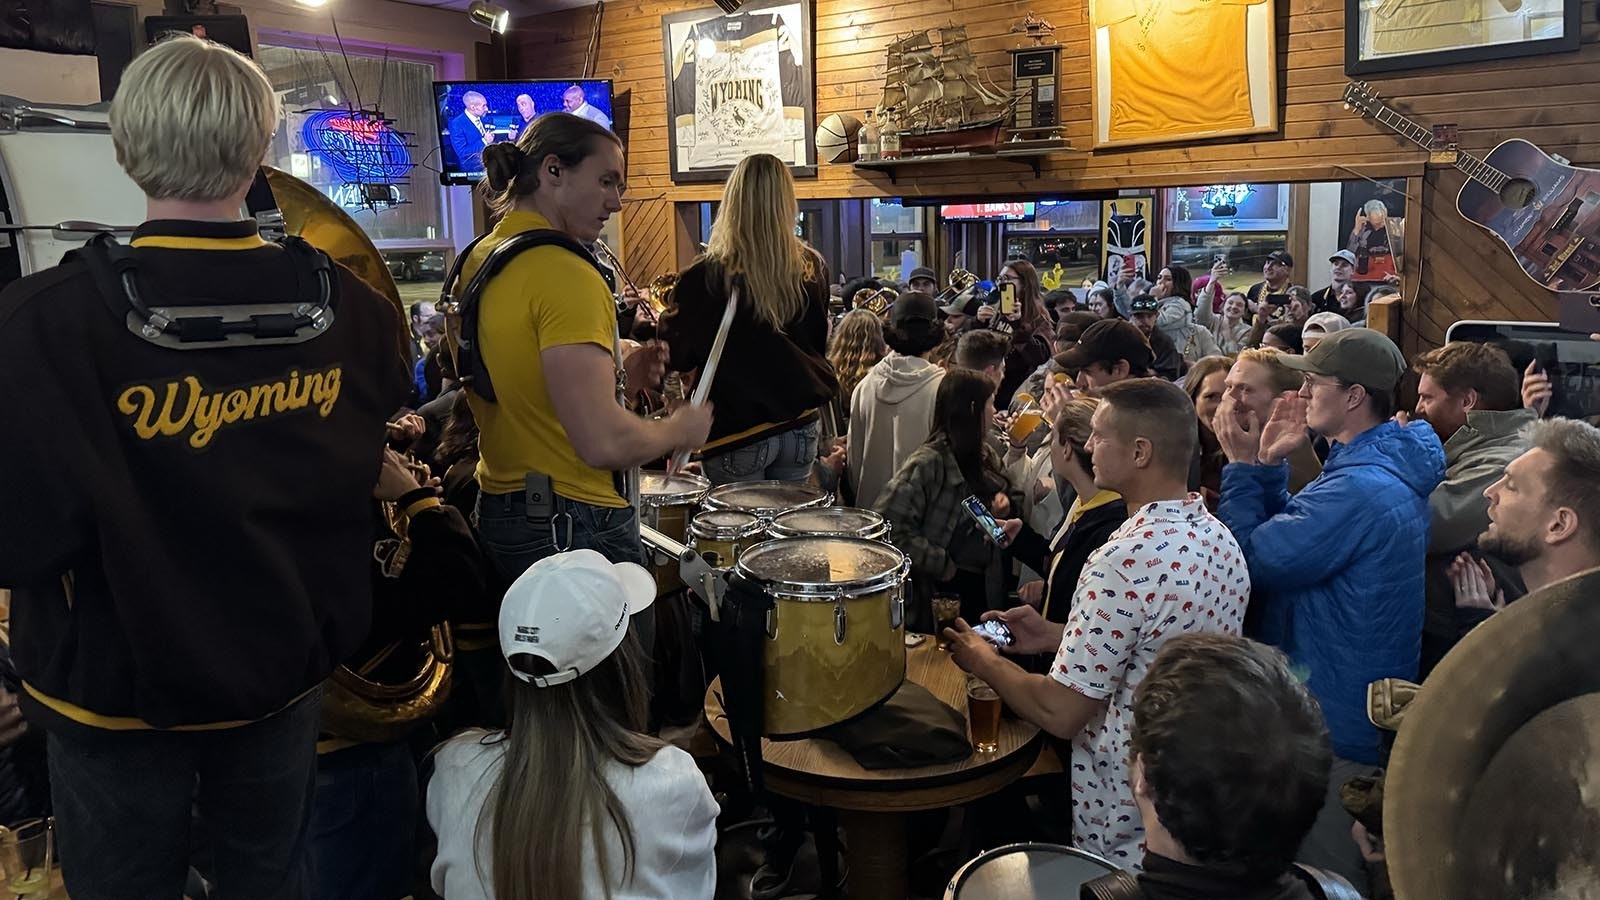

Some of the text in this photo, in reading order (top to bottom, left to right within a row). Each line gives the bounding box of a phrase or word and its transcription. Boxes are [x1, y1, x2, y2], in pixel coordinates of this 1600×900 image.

[710, 78, 764, 113] WYOMING
[117, 367, 342, 449] Wyoming
[1096, 608, 1112, 622] Bills
